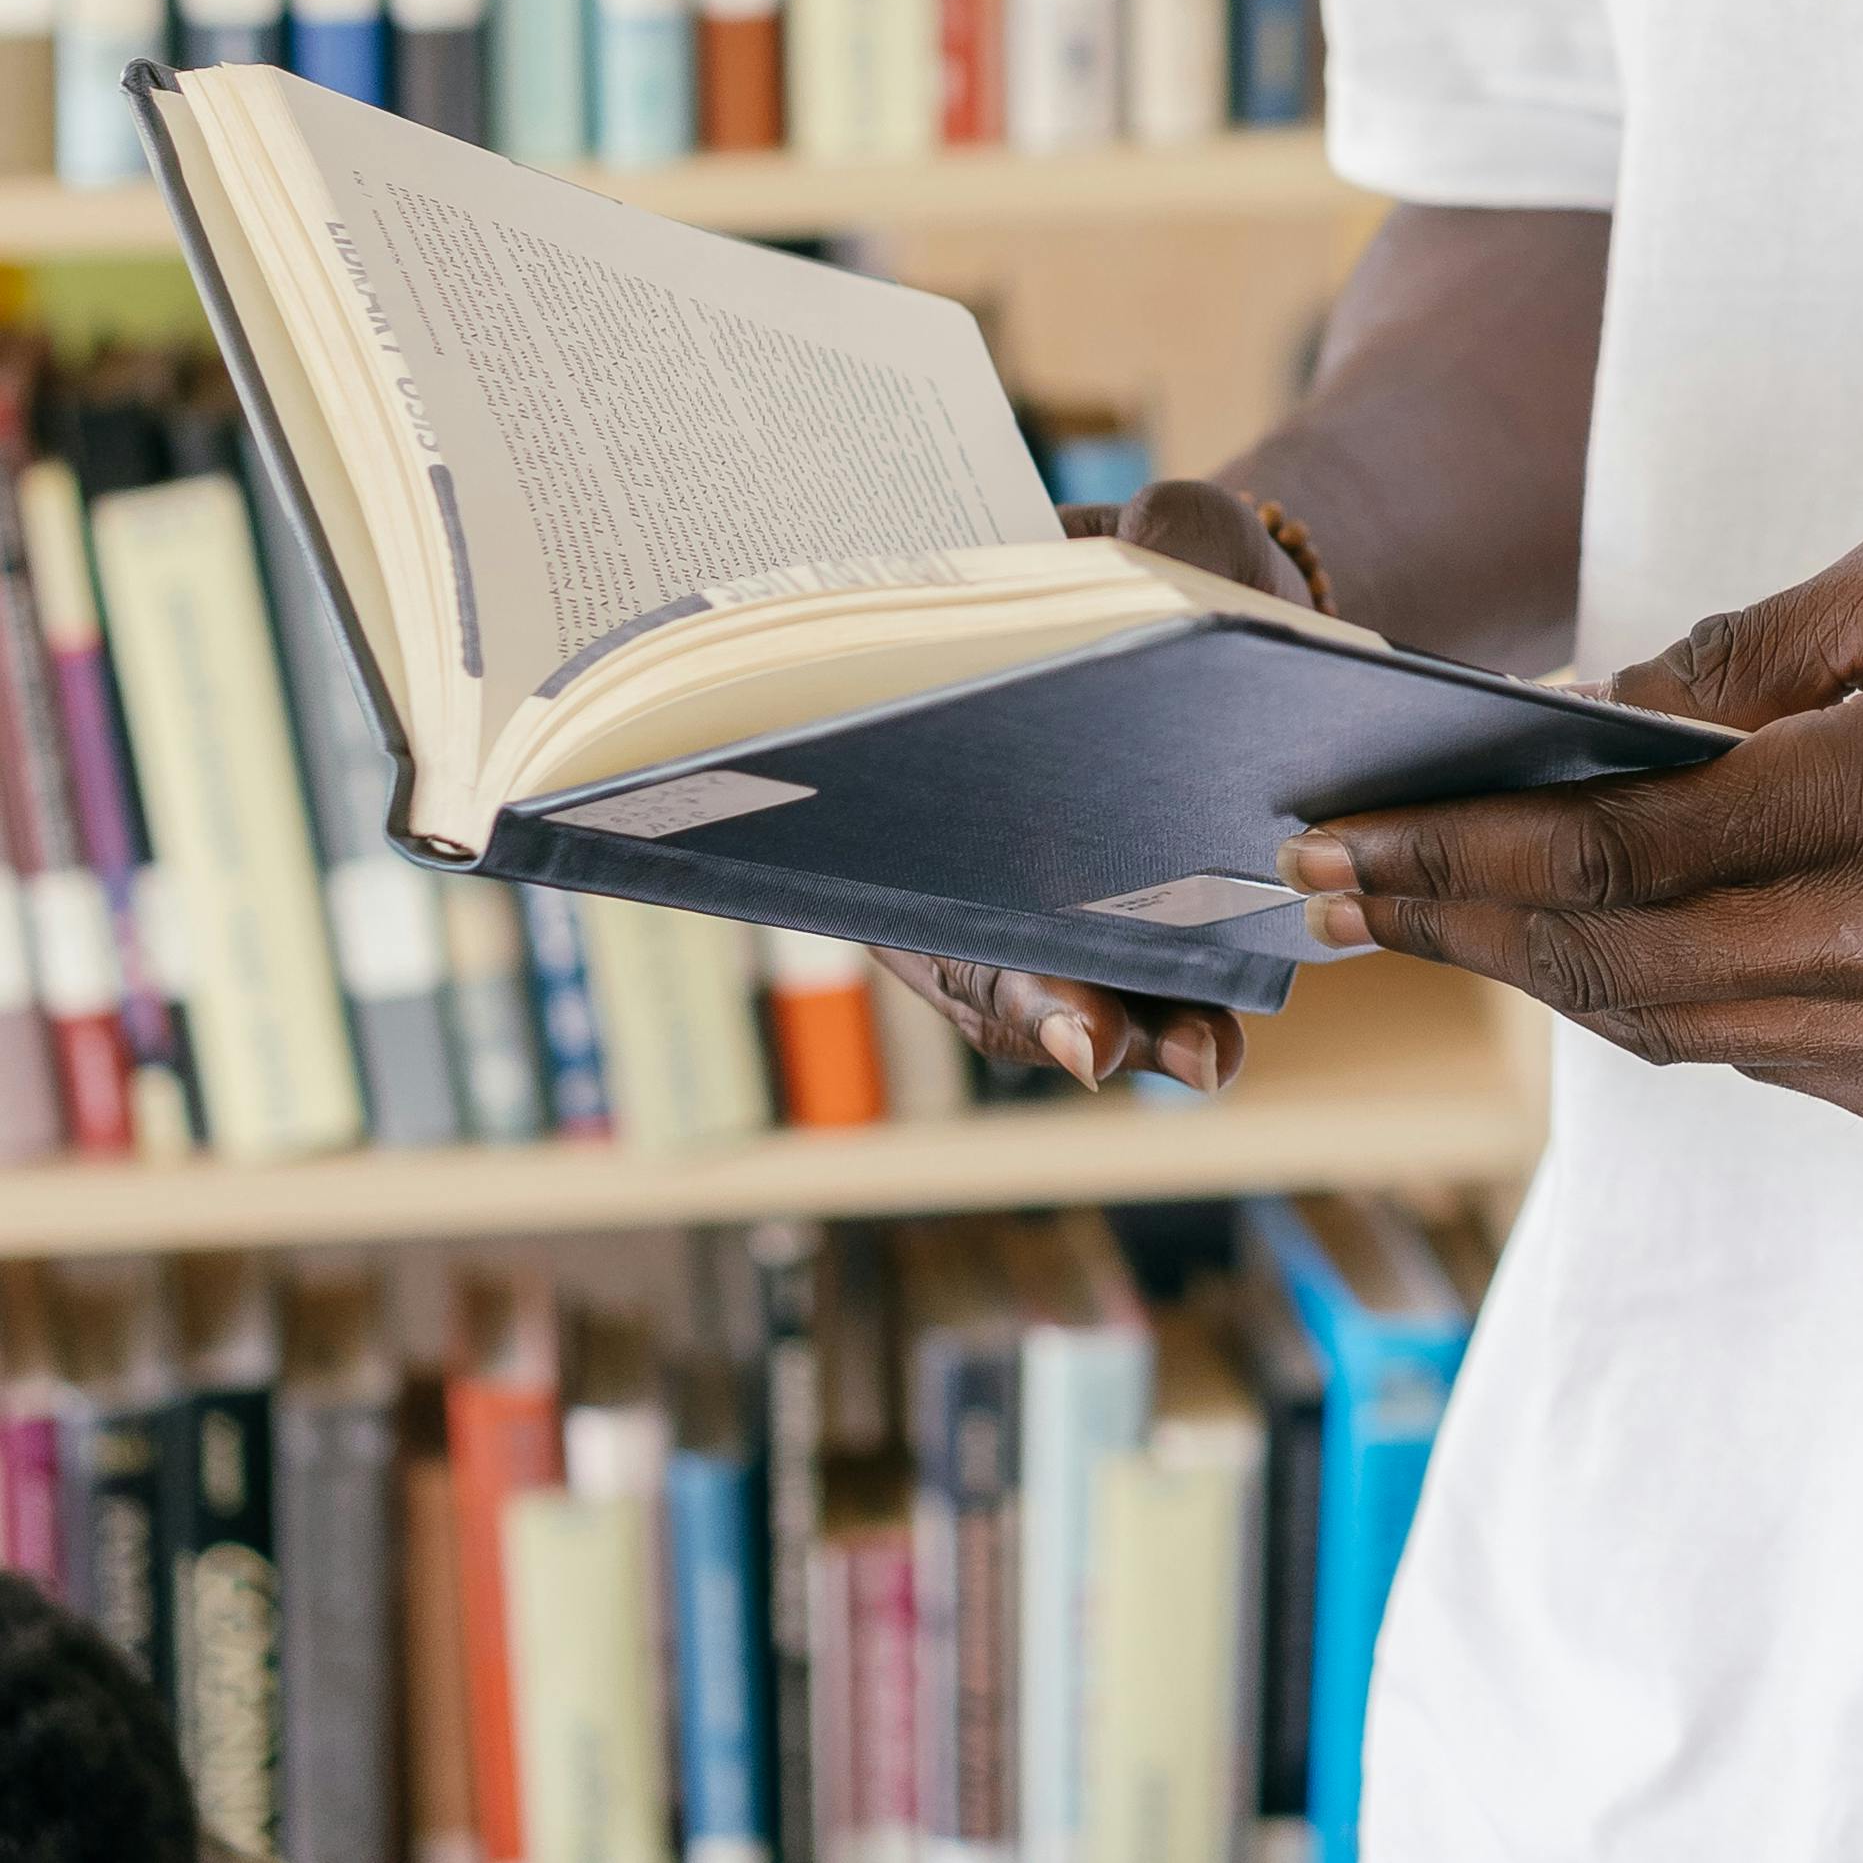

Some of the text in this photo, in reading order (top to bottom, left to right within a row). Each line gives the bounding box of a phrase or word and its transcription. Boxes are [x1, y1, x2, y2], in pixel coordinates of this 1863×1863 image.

[372, 209, 403, 265] Schemes
[429, 198, 449, 224] and
[446, 204, 458, 217] at
[448, 230, 482, 286] percent,
[459, 225, 497, 296] migration,
[519, 231, 540, 257] and
[548, 242, 568, 268] and
[400, 270, 444, 355] Resettlement
[496, 302, 520, 341] much
[536, 262, 578, 334] developed
[492, 324, 526, 381] reached
[519, 348, 537, 378] how
[575, 340, 603, 382] Brazil
[588, 314, 622, 372] Amazon
[462, 210, 635, 589] what conditions, to allow for maximum sustainable
[566, 250, 720, 550] objective of the Northwest Regional Devel-
[602, 364, 617, 386] the
[619, 374, 634, 396] the
[633, 357, 670, 415] promote
[385, 182, 568, 658] licymakers were well aware of both the population pressures in
[398, 187, 581, 628] and Northeast and the fact that the Amazon region could
[416, 194, 597, 626] that population overflow. By 1980, the annual population
[491, 221, 670, 602] igration of Brazilians into the Amazon region was not
[509, 227, 681, 584] government programs, although it certainly was
[523, 386, 558, 455] Rondônia
[627, 396, 643, 414] of
[666, 419, 677, 433] to
[553, 460, 567, 476] of
[558, 431, 592, 501] questions
[629, 444, 644, 466] the
[637, 433, 677, 510] Integration
[640, 417, 690, 511] Development
[642, 473, 654, 487] In
[676, 438, 712, 504] explicitly
[691, 450, 711, 477] and
[564, 481, 582, 515] state
[588, 507, 603, 535] The
[686, 514, 702, 536] for
[710, 510, 726, 533] not
[655, 498, 687, 561] projects.
[672, 515, 705, 579] National
[726, 539, 740, 566] was
[579, 521, 610, 612] Amazonian
[602, 551, 627, 610] percent.
[698, 540, 719, 579] Plans
